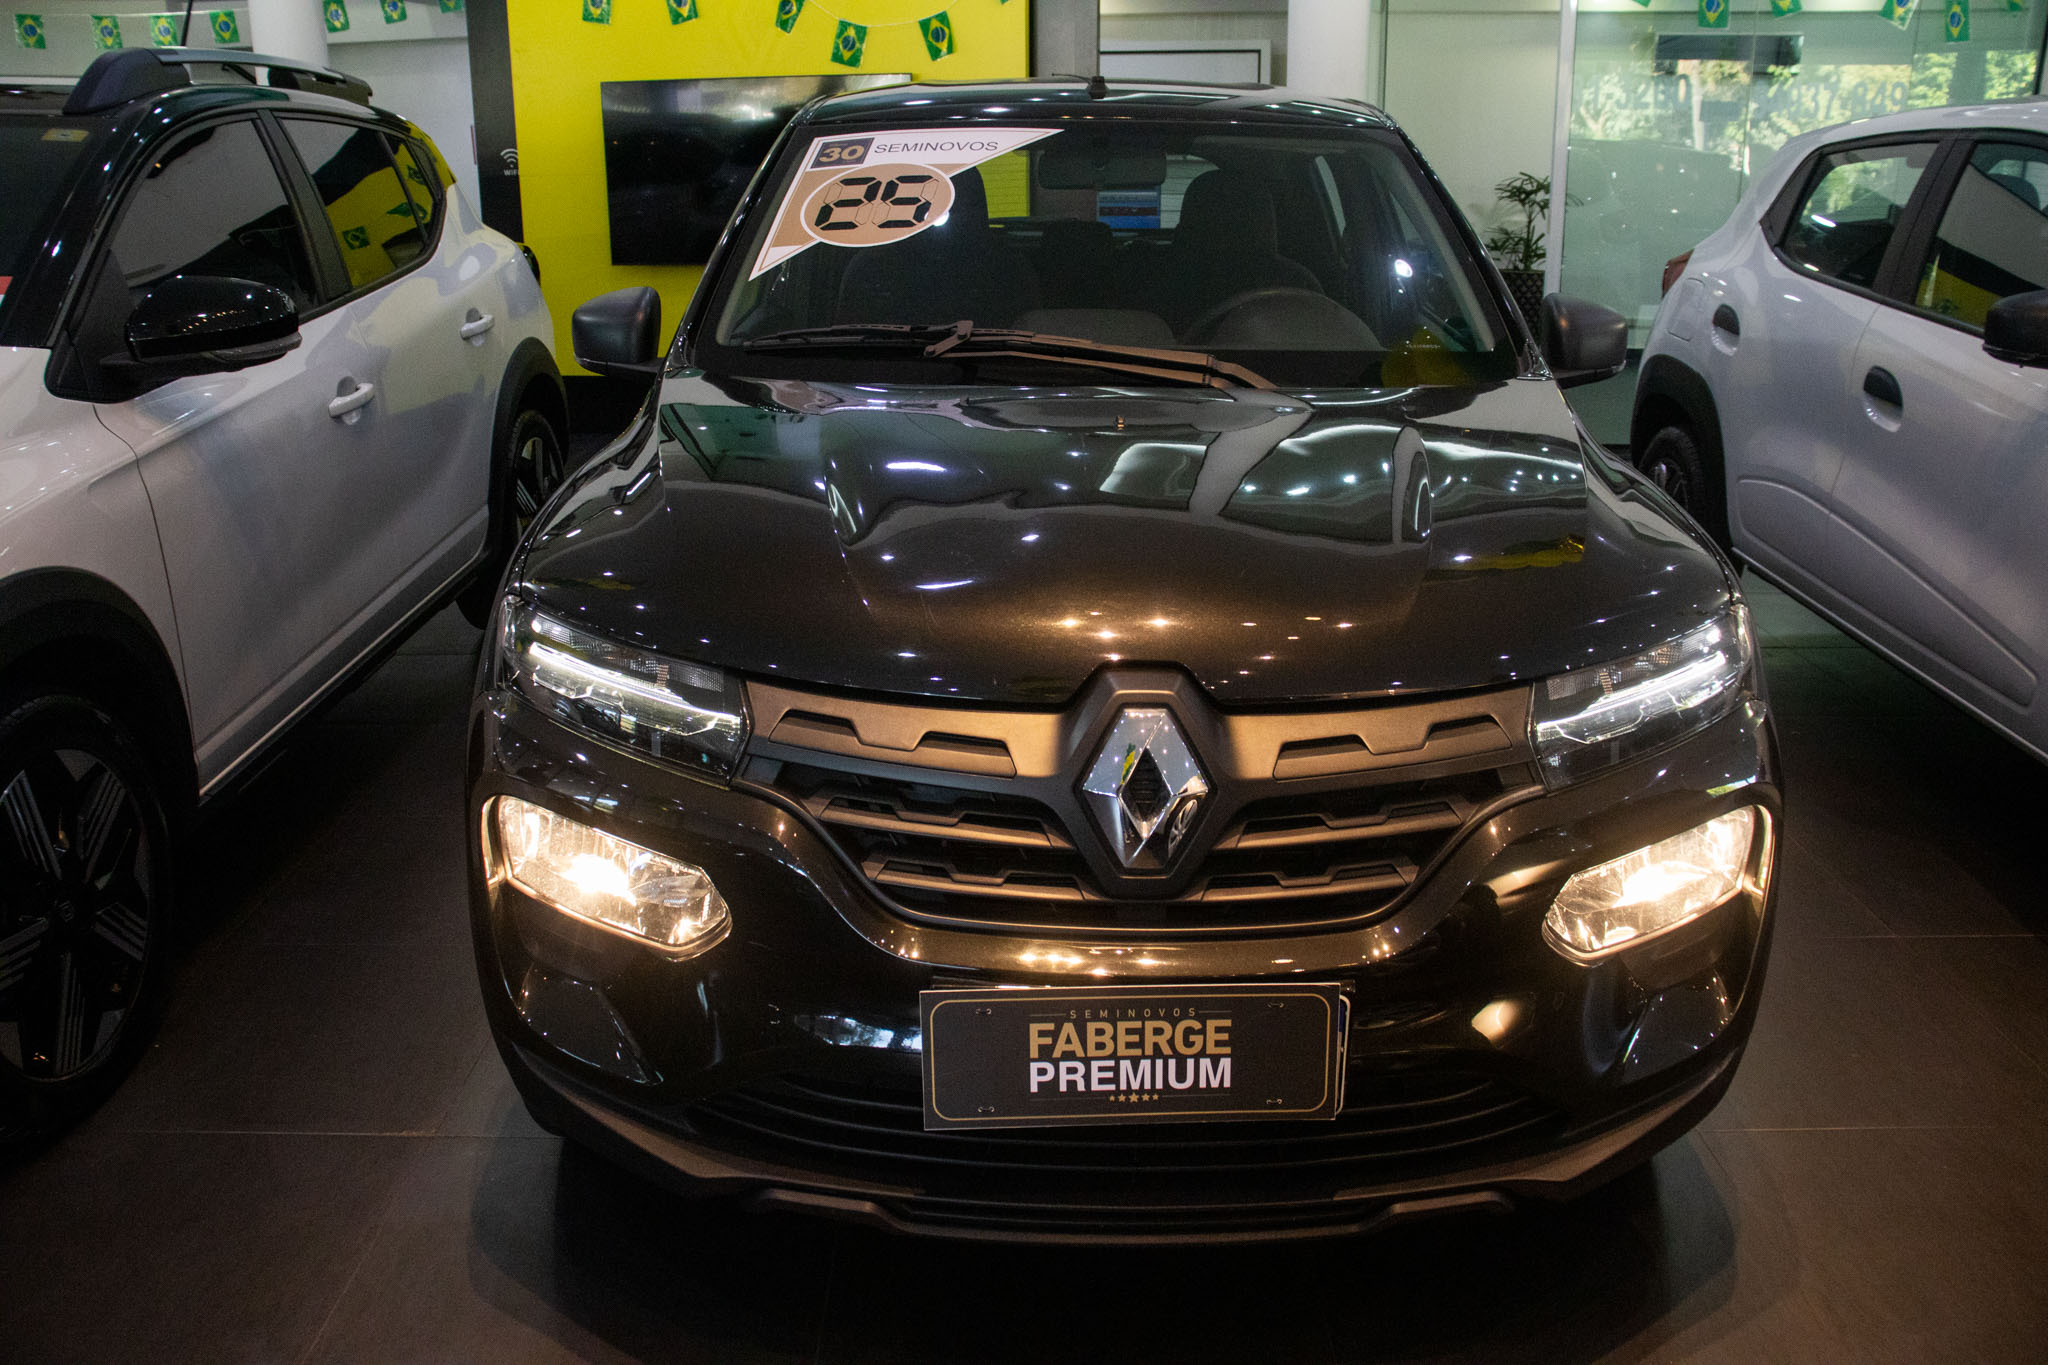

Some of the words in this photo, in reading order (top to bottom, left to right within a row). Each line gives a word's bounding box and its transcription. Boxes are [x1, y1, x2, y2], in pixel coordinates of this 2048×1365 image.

[818, 145, 865, 163] 30
[874, 140, 998, 154] SEMINOVOS
[815, 175, 932, 230] 25
[1070, 1008, 1197, 1019] SEMINOVOS
[1029, 1018, 1232, 1058] FABERGE
[1029, 1057, 1231, 1093] PREMIUM
